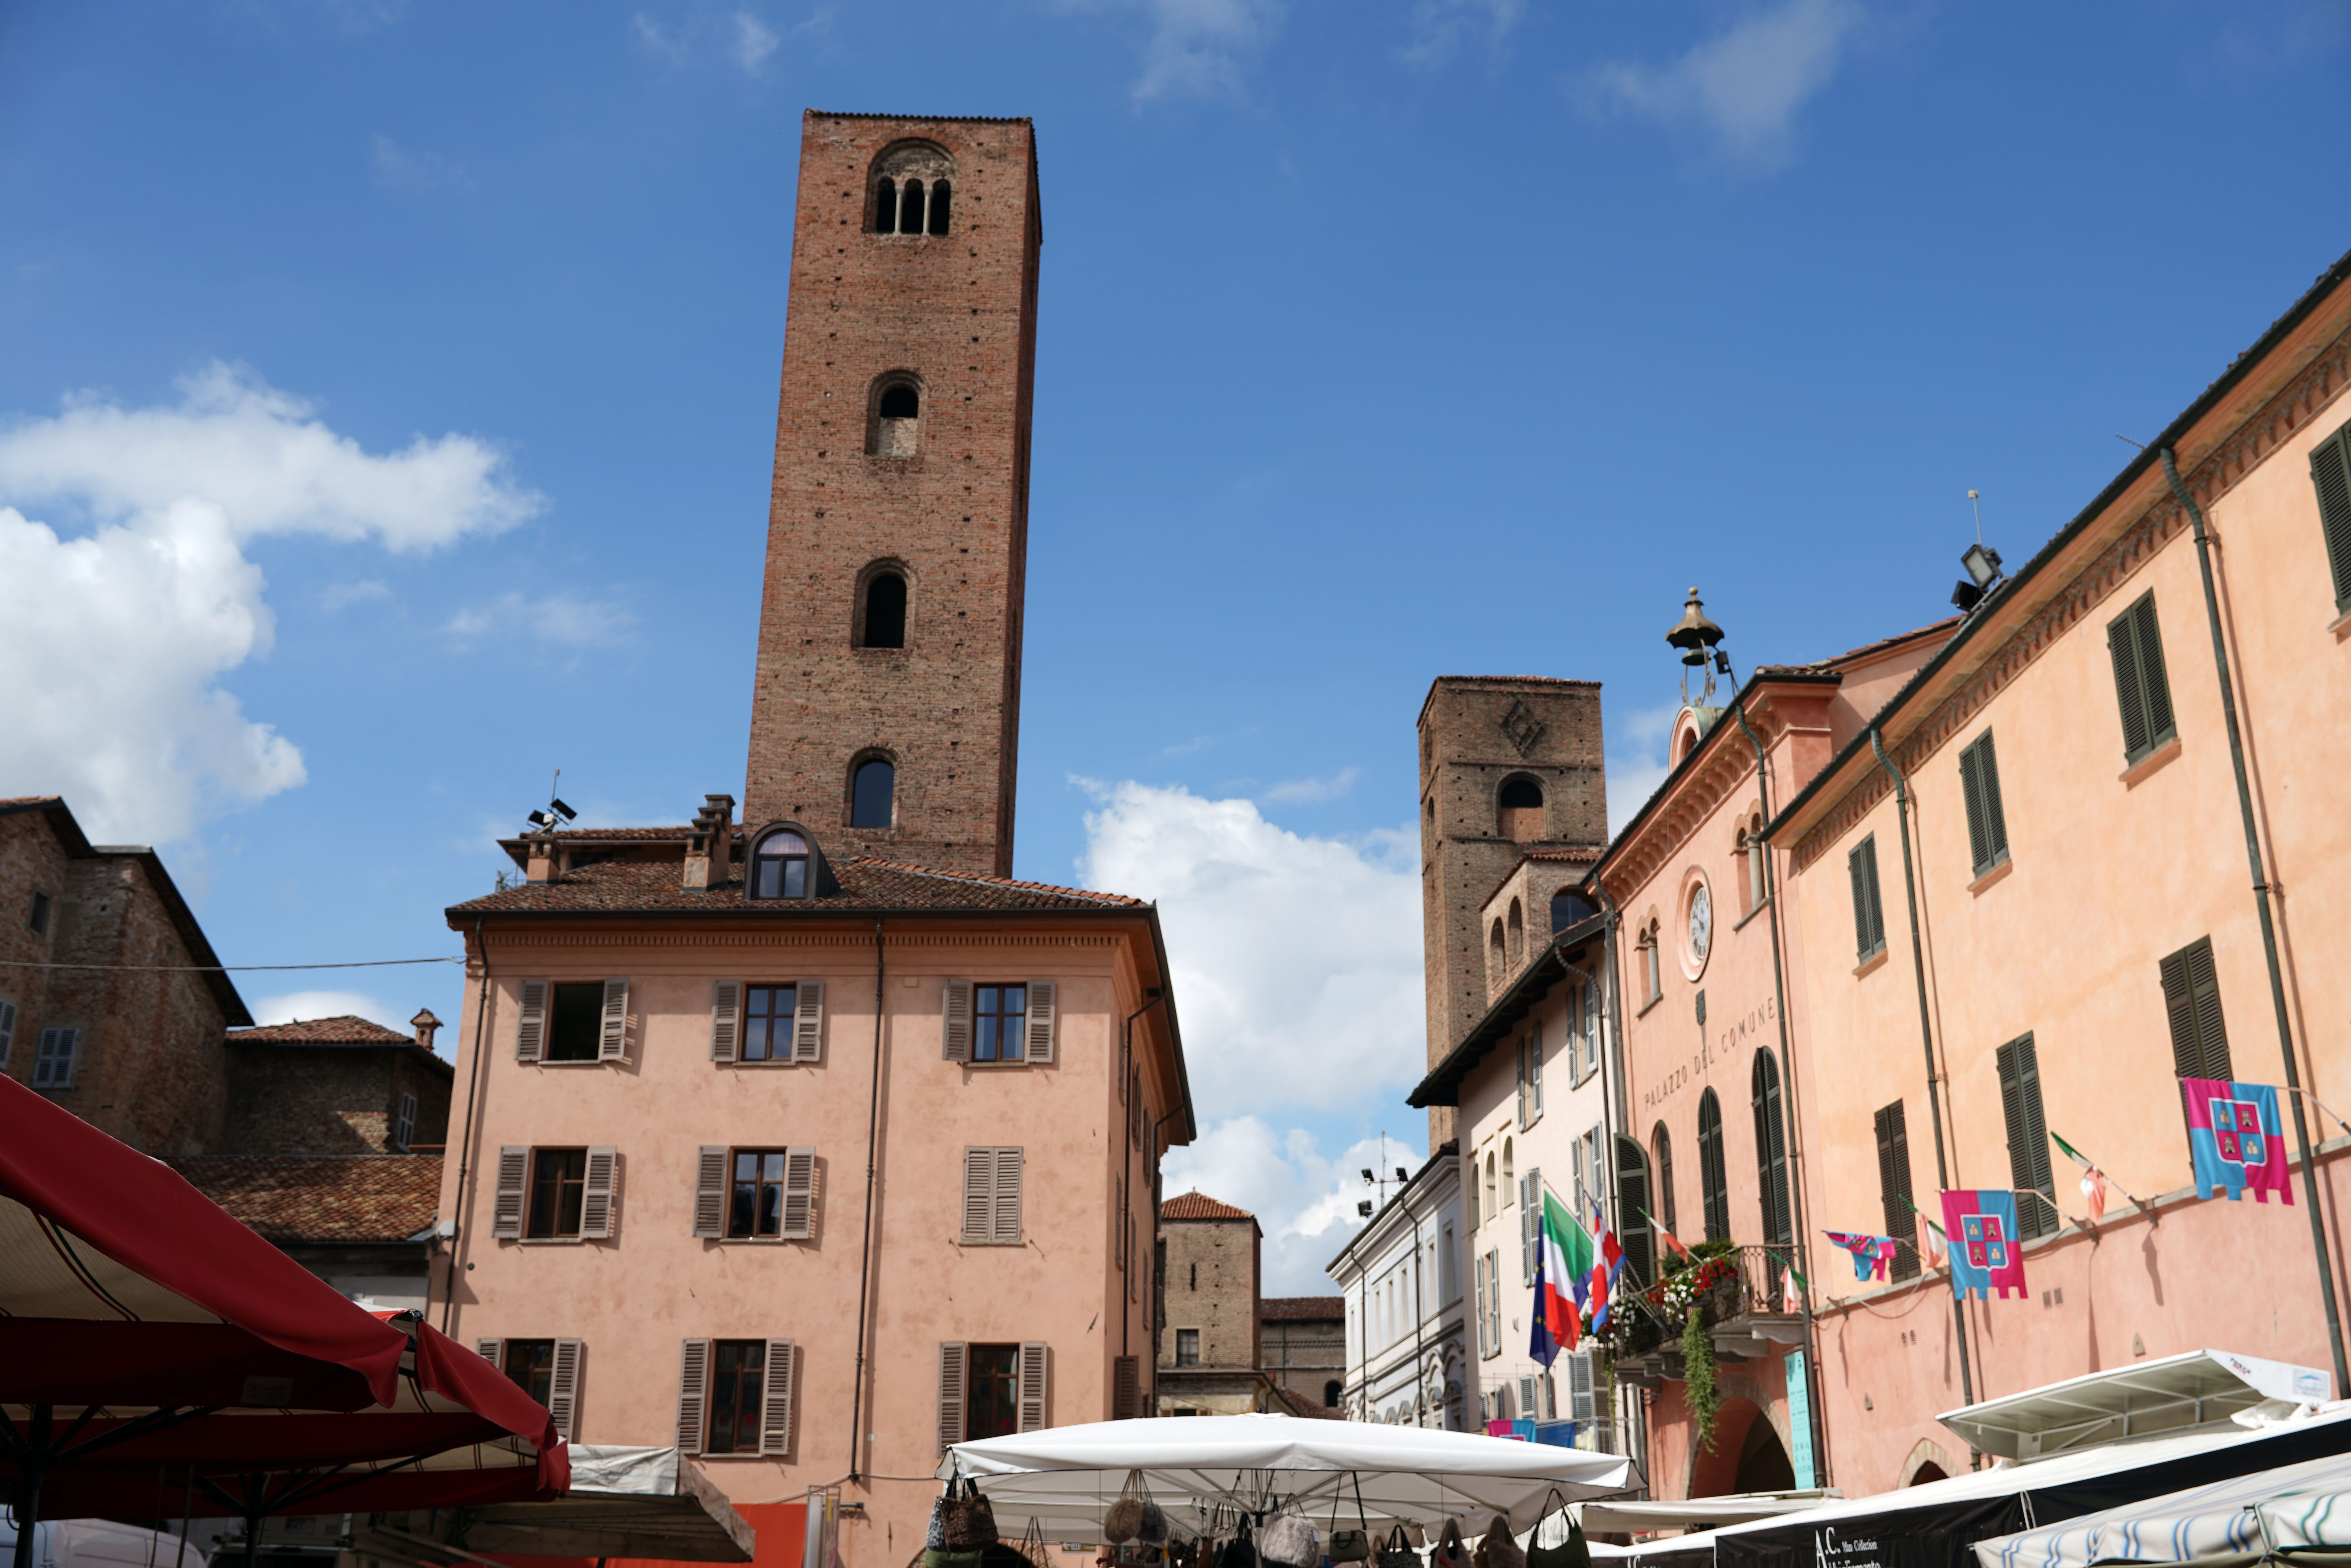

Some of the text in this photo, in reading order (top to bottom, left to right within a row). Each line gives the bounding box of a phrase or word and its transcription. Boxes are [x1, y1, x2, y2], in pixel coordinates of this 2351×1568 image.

[1645, 997, 1775, 1112] PALAZZO DEL COMUNE
[1853, 1538, 1878, 1552] Collection
